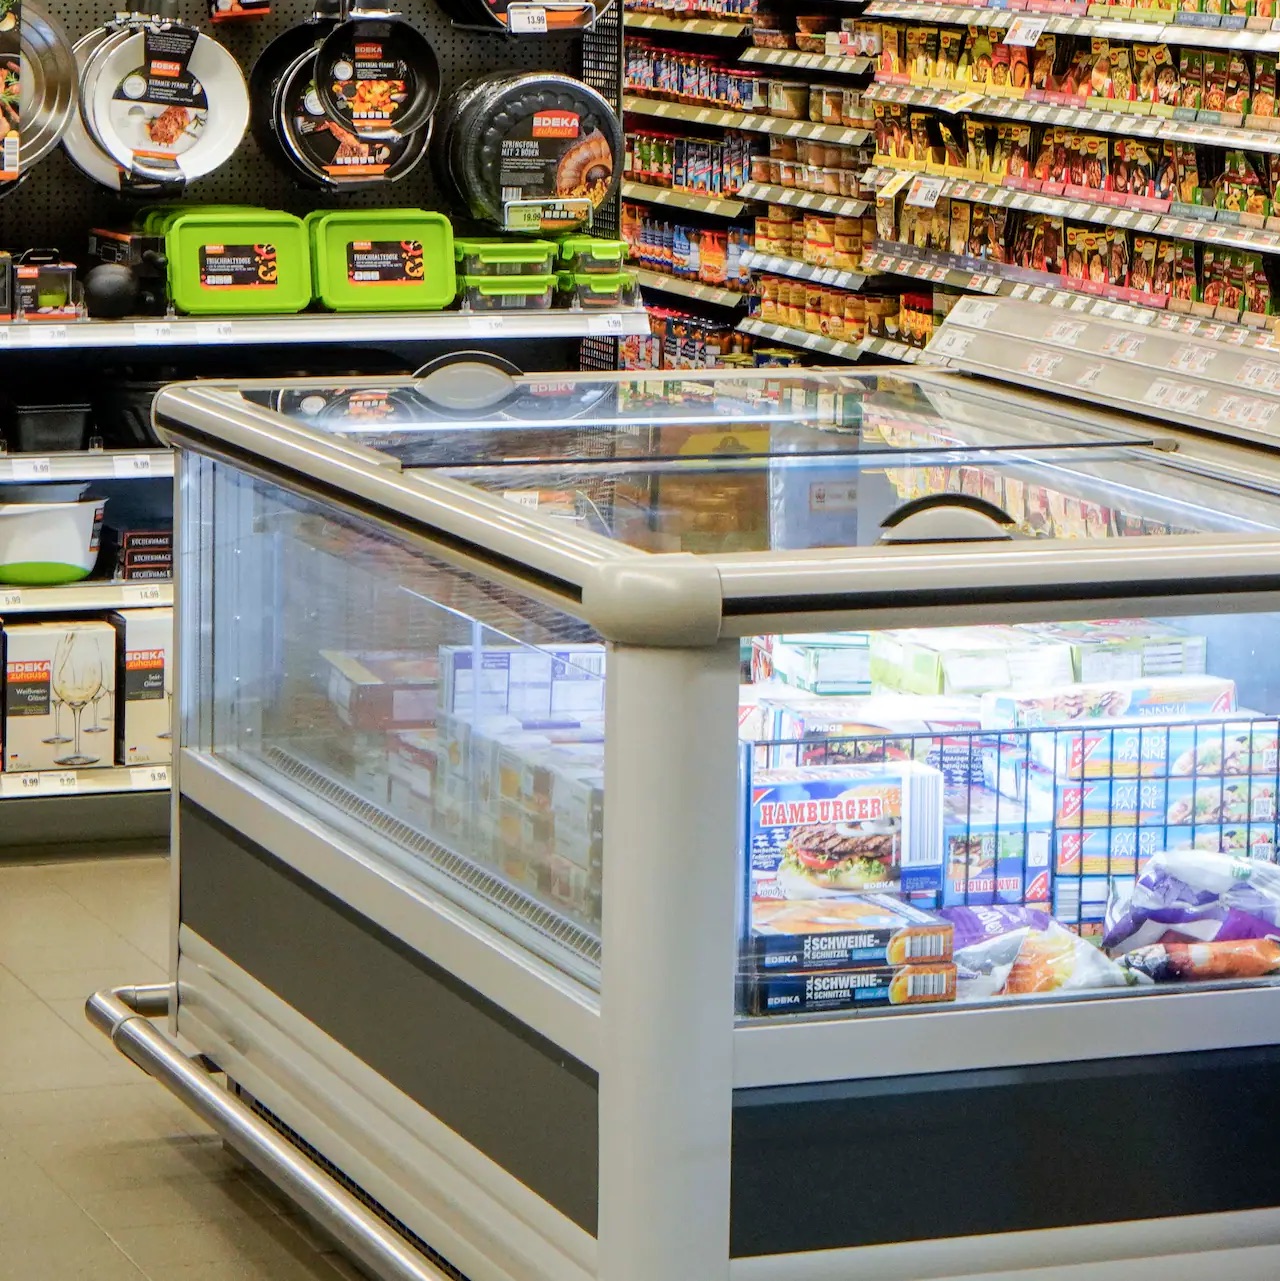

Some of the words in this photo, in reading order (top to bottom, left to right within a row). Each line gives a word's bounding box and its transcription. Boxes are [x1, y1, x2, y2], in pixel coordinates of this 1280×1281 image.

[354, 45, 383, 55] EDEKA
[151, 62, 181, 71] EDEKA
[533, 116, 580, 127] EDEKA
[536, 126, 573, 137] zuhause
[501, 140, 539, 149] SPRINGFORM
[126, 650, 164, 660] EDEKA
[8, 661, 50, 672] EDEKA
[128, 659, 162, 668] zuhause
[10, 671, 48, 681] zuhause
[27, 695, 47, 703] Gläser
[1117, 748, 1166, 761] PFANNE
[760, 797, 884, 826] HAMBURGER
[863, 880, 895, 890] EDEKA
[803, 935, 812, 960] XXL
[812, 934, 881, 951] SCHWEINE-
[764, 954, 798, 965] EDEKA
[811, 950, 849, 959] SCHNITZEL
[805, 976, 814, 1000] XXL
[814, 975, 882, 991] SCHWEINE-
[814, 989, 852, 1000] SCHNITZEL
[767, 995, 800, 1006] EDEKA
